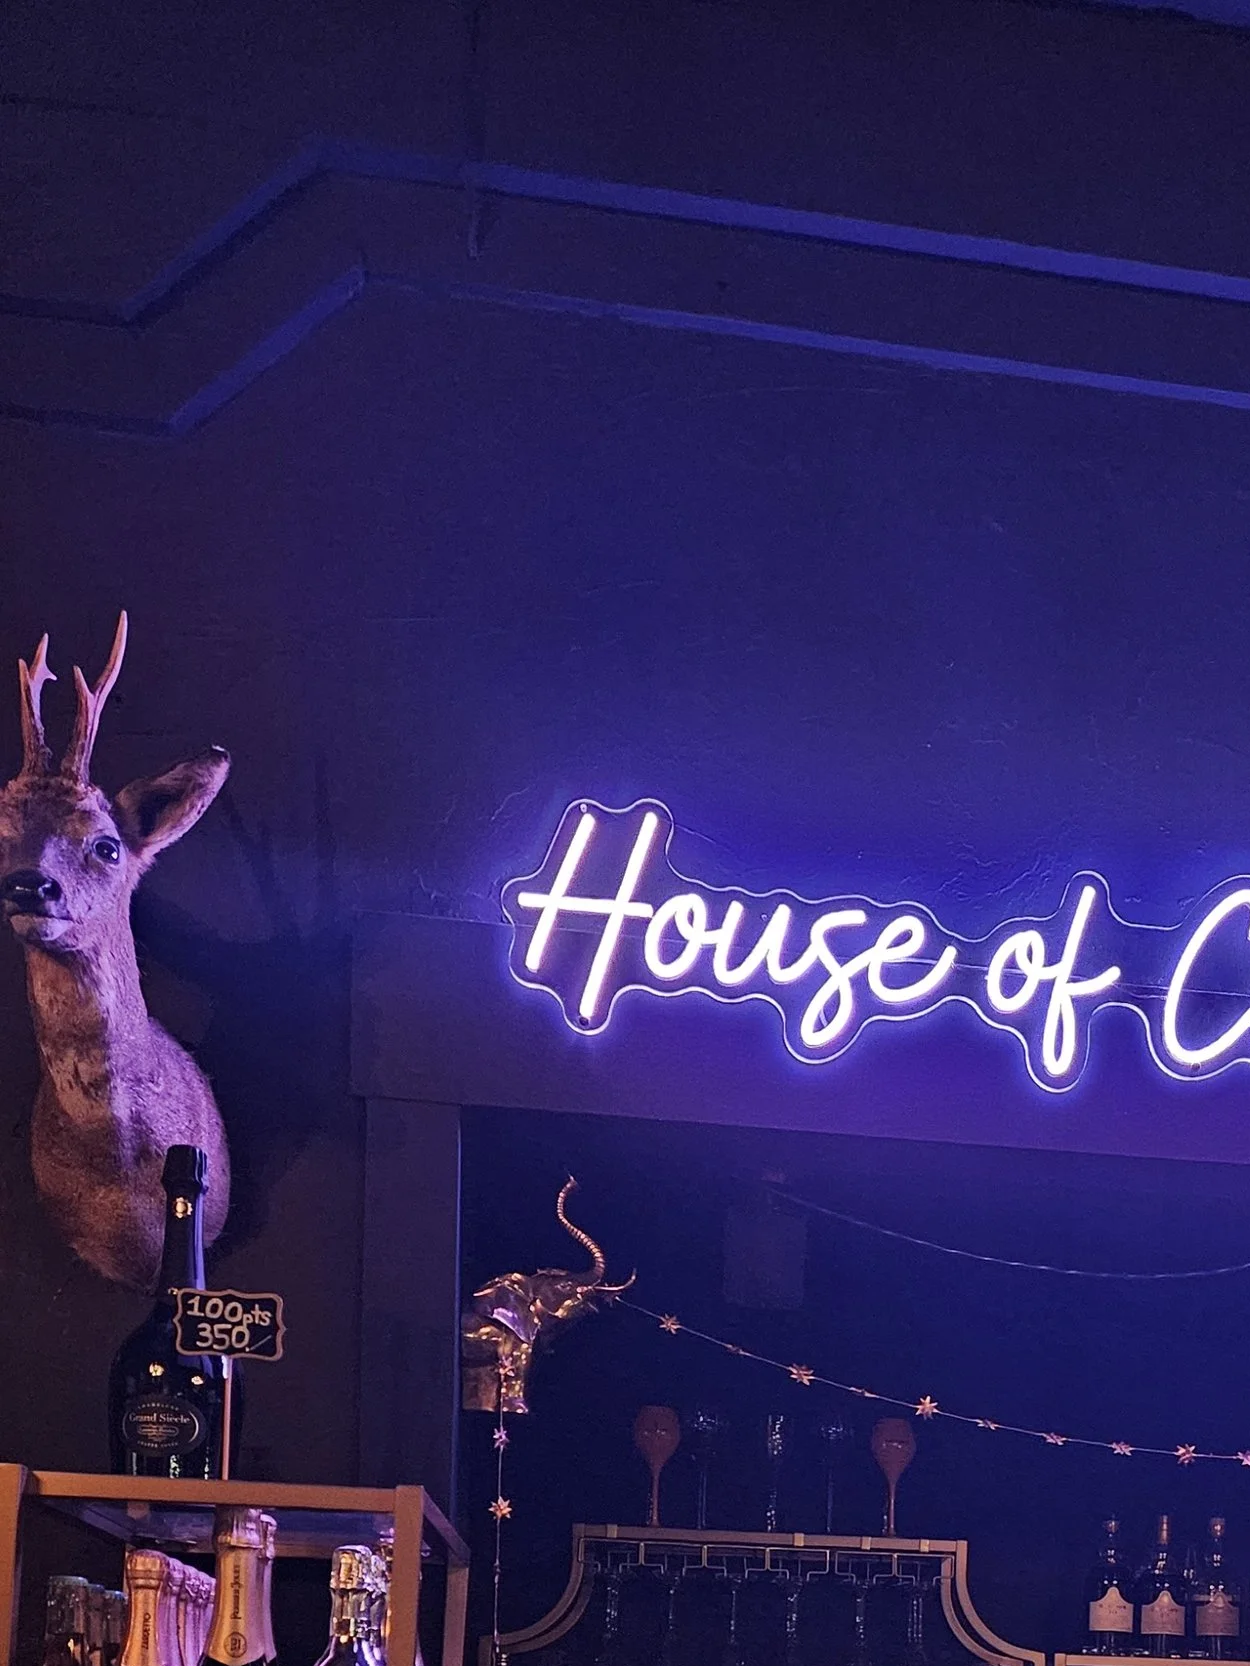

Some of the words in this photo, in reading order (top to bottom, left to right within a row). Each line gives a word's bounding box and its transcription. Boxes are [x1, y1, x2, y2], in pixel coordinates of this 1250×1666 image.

[517, 811, 957, 1046] House
[985, 885, 1121, 1076] of
[186, 1295, 273, 1328] 100pts
